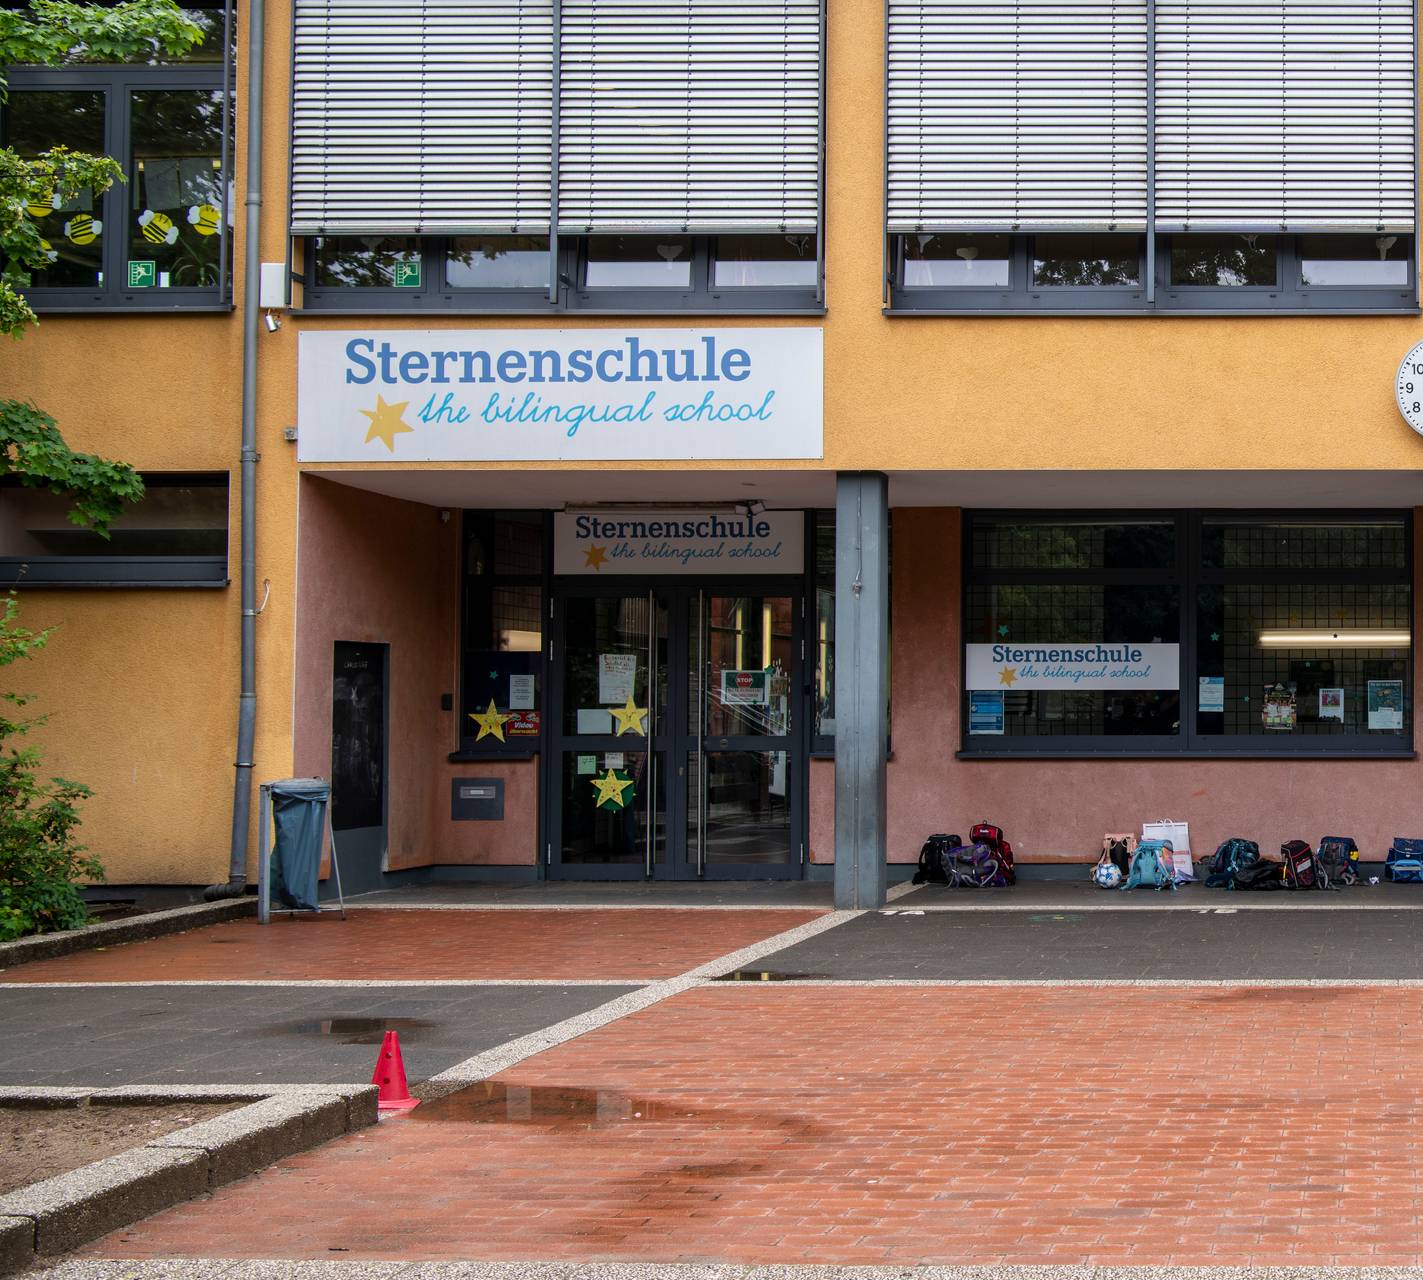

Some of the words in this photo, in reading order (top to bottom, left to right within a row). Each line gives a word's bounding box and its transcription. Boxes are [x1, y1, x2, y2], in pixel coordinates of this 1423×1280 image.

[345, 336, 751, 385] Sternenschule
[1406, 382, 1414, 393] 9
[417, 392, 470, 424] the
[480, 391, 655, 437] bilingual
[663, 390, 776, 422] school
[1412, 401, 1421, 413] 8
[576, 515, 770, 539] Sternenschule
[610, 542, 637, 558] the
[641, 542, 725, 565] bilingual
[728, 541, 782, 558] school
[992, 645, 1142, 663] Sternenschule
[1019, 665, 1039, 678] the
[1043, 665, 1106, 683] bilingual
[1109, 665, 1151, 678] school
